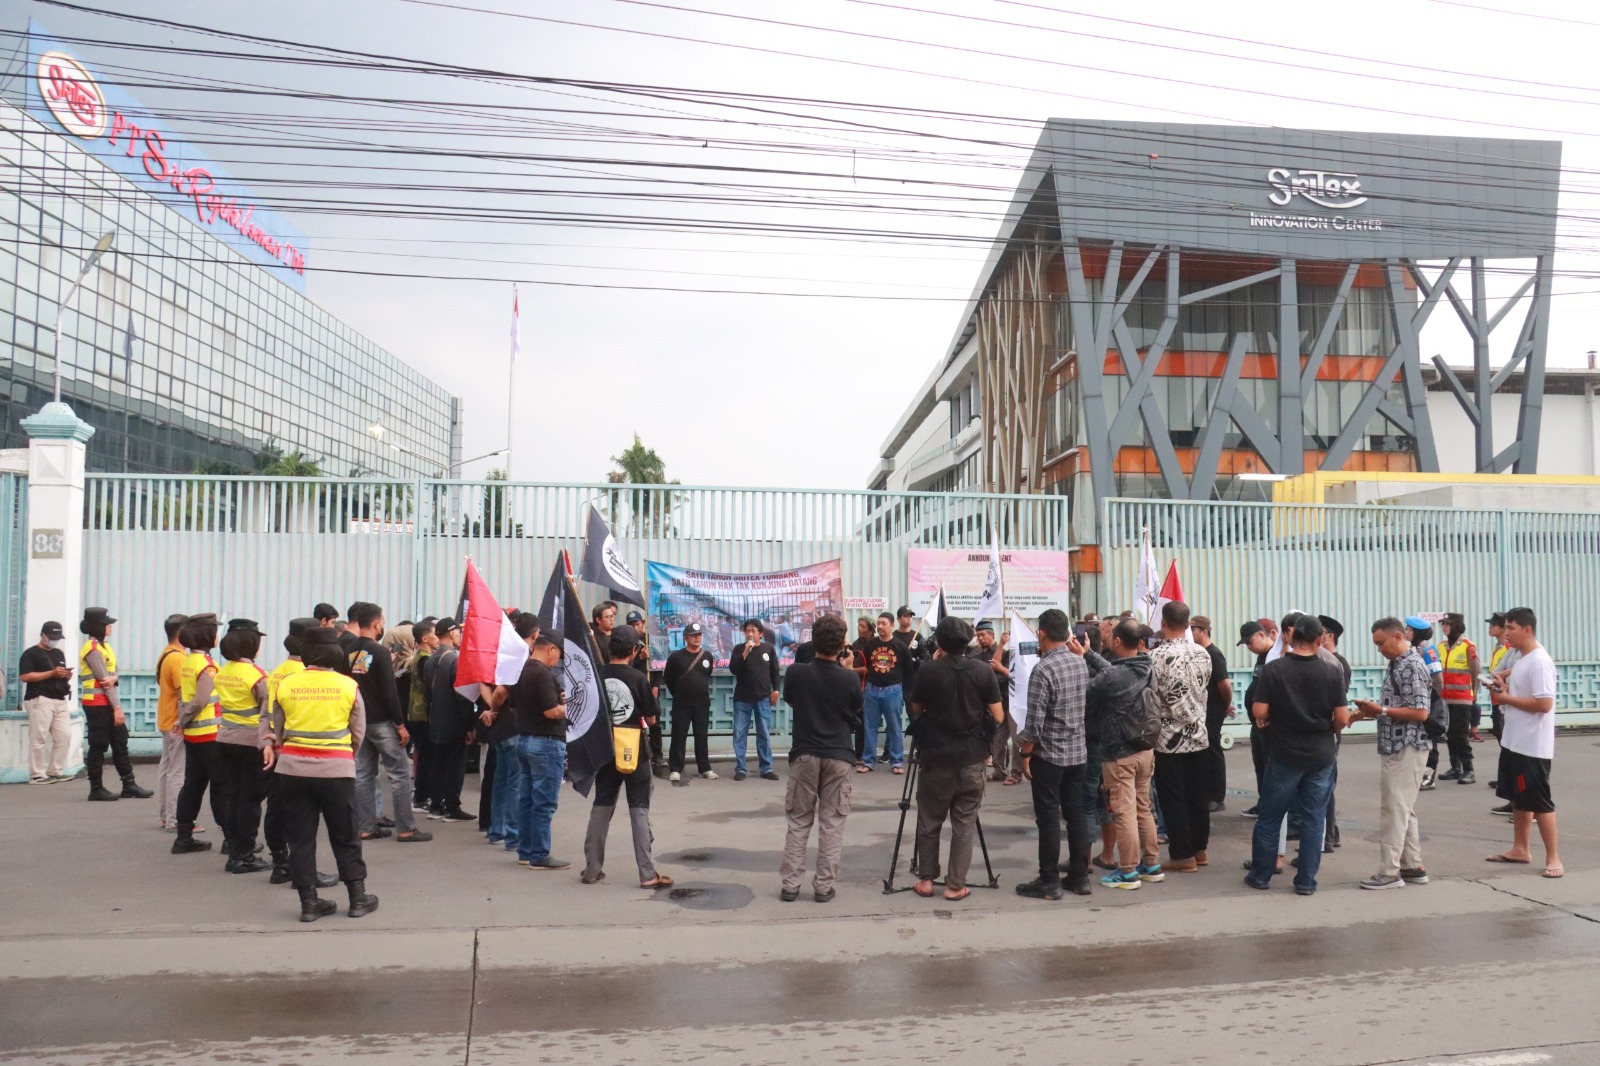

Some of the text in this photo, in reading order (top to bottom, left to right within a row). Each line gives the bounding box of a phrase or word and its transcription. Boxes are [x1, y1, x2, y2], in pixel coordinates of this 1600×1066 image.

[108, 111, 142, 158] PT
[142, 129, 184, 193] Sri
[1250, 212, 1382, 230] INNOVATION CENTER
[968, 554, 1012, 563] ANNOUNENT
[685, 570, 705, 580] SATU
[671, 576, 818, 590] SATU TAHUN HAK TAK KUNJUNG DATANG
[290, 687, 341, 695] NEGOSIATOR
